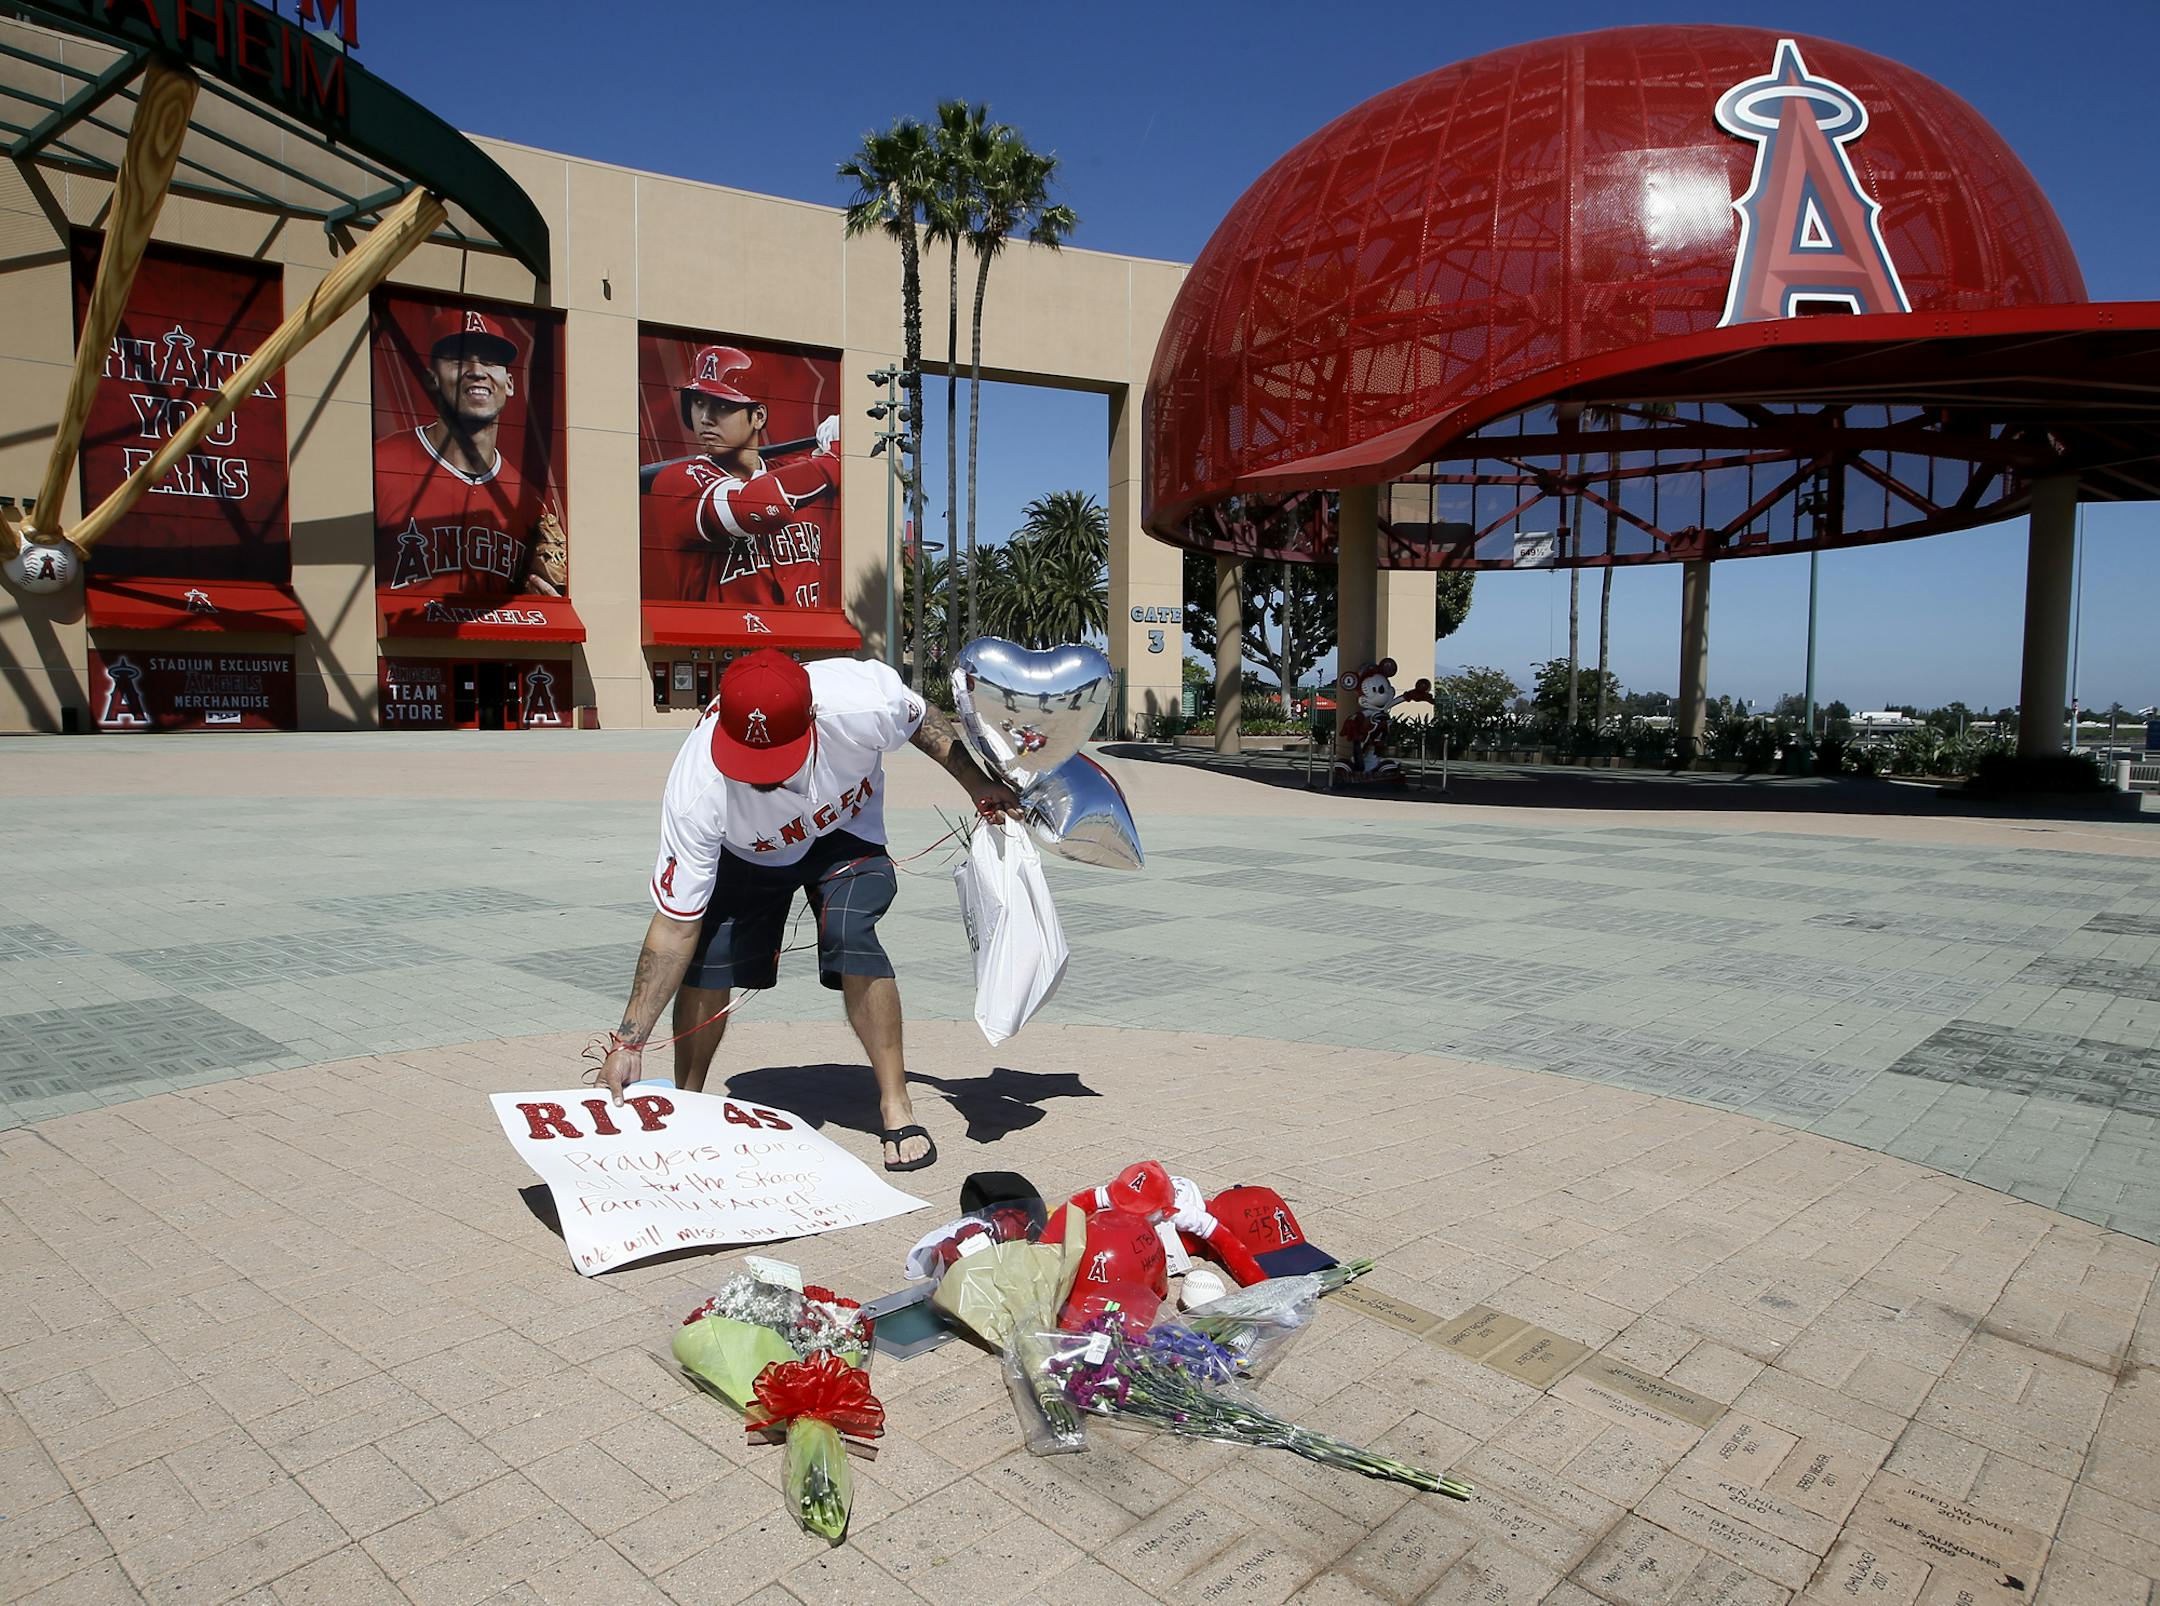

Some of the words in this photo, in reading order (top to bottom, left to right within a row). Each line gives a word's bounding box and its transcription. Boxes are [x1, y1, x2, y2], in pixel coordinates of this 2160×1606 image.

[129, 393, 238, 446] YOU
[423, 600, 548, 626] ANGELS
[1130, 606, 1182, 623] GATE
[1147, 629, 1165, 654] 3
[150, 658, 213, 671] STADIUM
[220, 660, 289, 673] EXCLUSIVE
[174, 695, 270, 709] MERCHANDISE
[389, 684, 438, 701] TEAM
[386, 704, 443, 720] STORE
[515, 1094, 676, 1140] RIP
[722, 1101, 795, 1131] 45
[564, 1144, 721, 1177] Prayers
[623, 1224, 664, 1252] will
[676, 1226, 726, 1243] miss
[1249, 1215, 1275, 1241] 45
[1612, 1367, 1647, 1386] JERED
[1648, 1381, 1696, 1405] WEAVER
[1584, 1386, 1623, 1405] JERED
[1623, 1402, 1673, 1427] WEAVER
[1718, 1481, 1749, 1499] KEN
[1754, 1497, 1786, 1516] HILL
[1728, 1495, 1767, 1514] 2000
[1903, 1487, 1950, 1510] JERED
[1953, 1505, 2015, 1535] WEAVER
[1473, 1494, 1509, 1514] MIKE
[1512, 1513, 1548, 1534] WITT
[1937, 1507, 1972, 1526] 2010
[1132, 1532, 1170, 1559] FRANK
[1168, 1508, 1209, 1536] TANANA
[1681, 1505, 1705, 1521] TIM
[1710, 1519, 1781, 1555] BELCHER
[1884, 1516, 1914, 1531] JOE
[1916, 1528, 2002, 1569] SAUNDERS
[1919, 1539, 1957, 1558] 2009
[1201, 1572, 1238, 1601] FRANK
[1235, 1547, 1276, 1577] TANANA
[1242, 1572, 1268, 1593] 1978
[1842, 1573, 1863, 1597] JOHN
[1856, 1549, 1878, 1578] LACKEY
